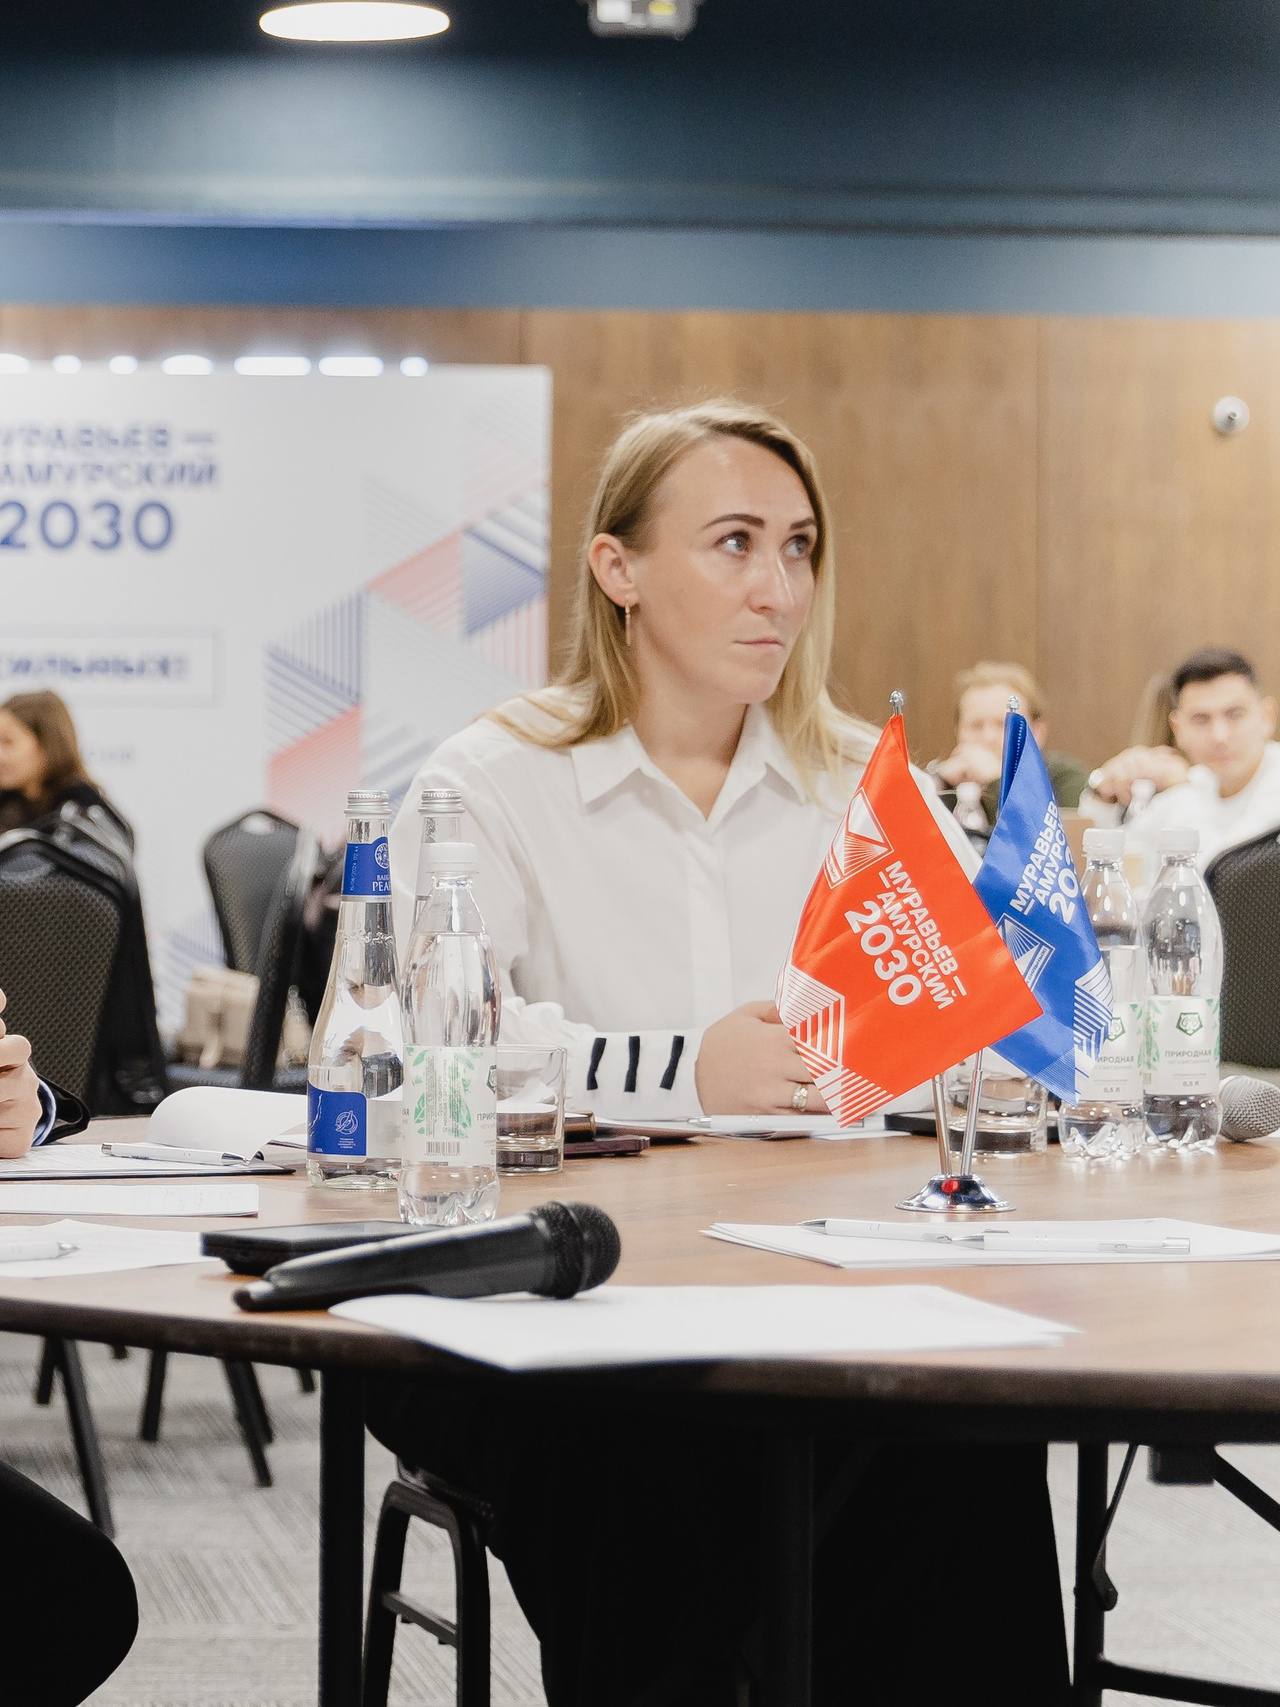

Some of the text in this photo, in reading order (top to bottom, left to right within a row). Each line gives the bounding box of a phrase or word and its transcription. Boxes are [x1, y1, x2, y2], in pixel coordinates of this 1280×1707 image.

[1009, 800, 1059, 913] МУРАВЬЕВ
[844, 900, 922, 1006] 2030
[1097, 1055, 1135, 1064] ИРОДНАЯ
[1164, 1050, 1212, 1058] ПРИРОДНАЯ
